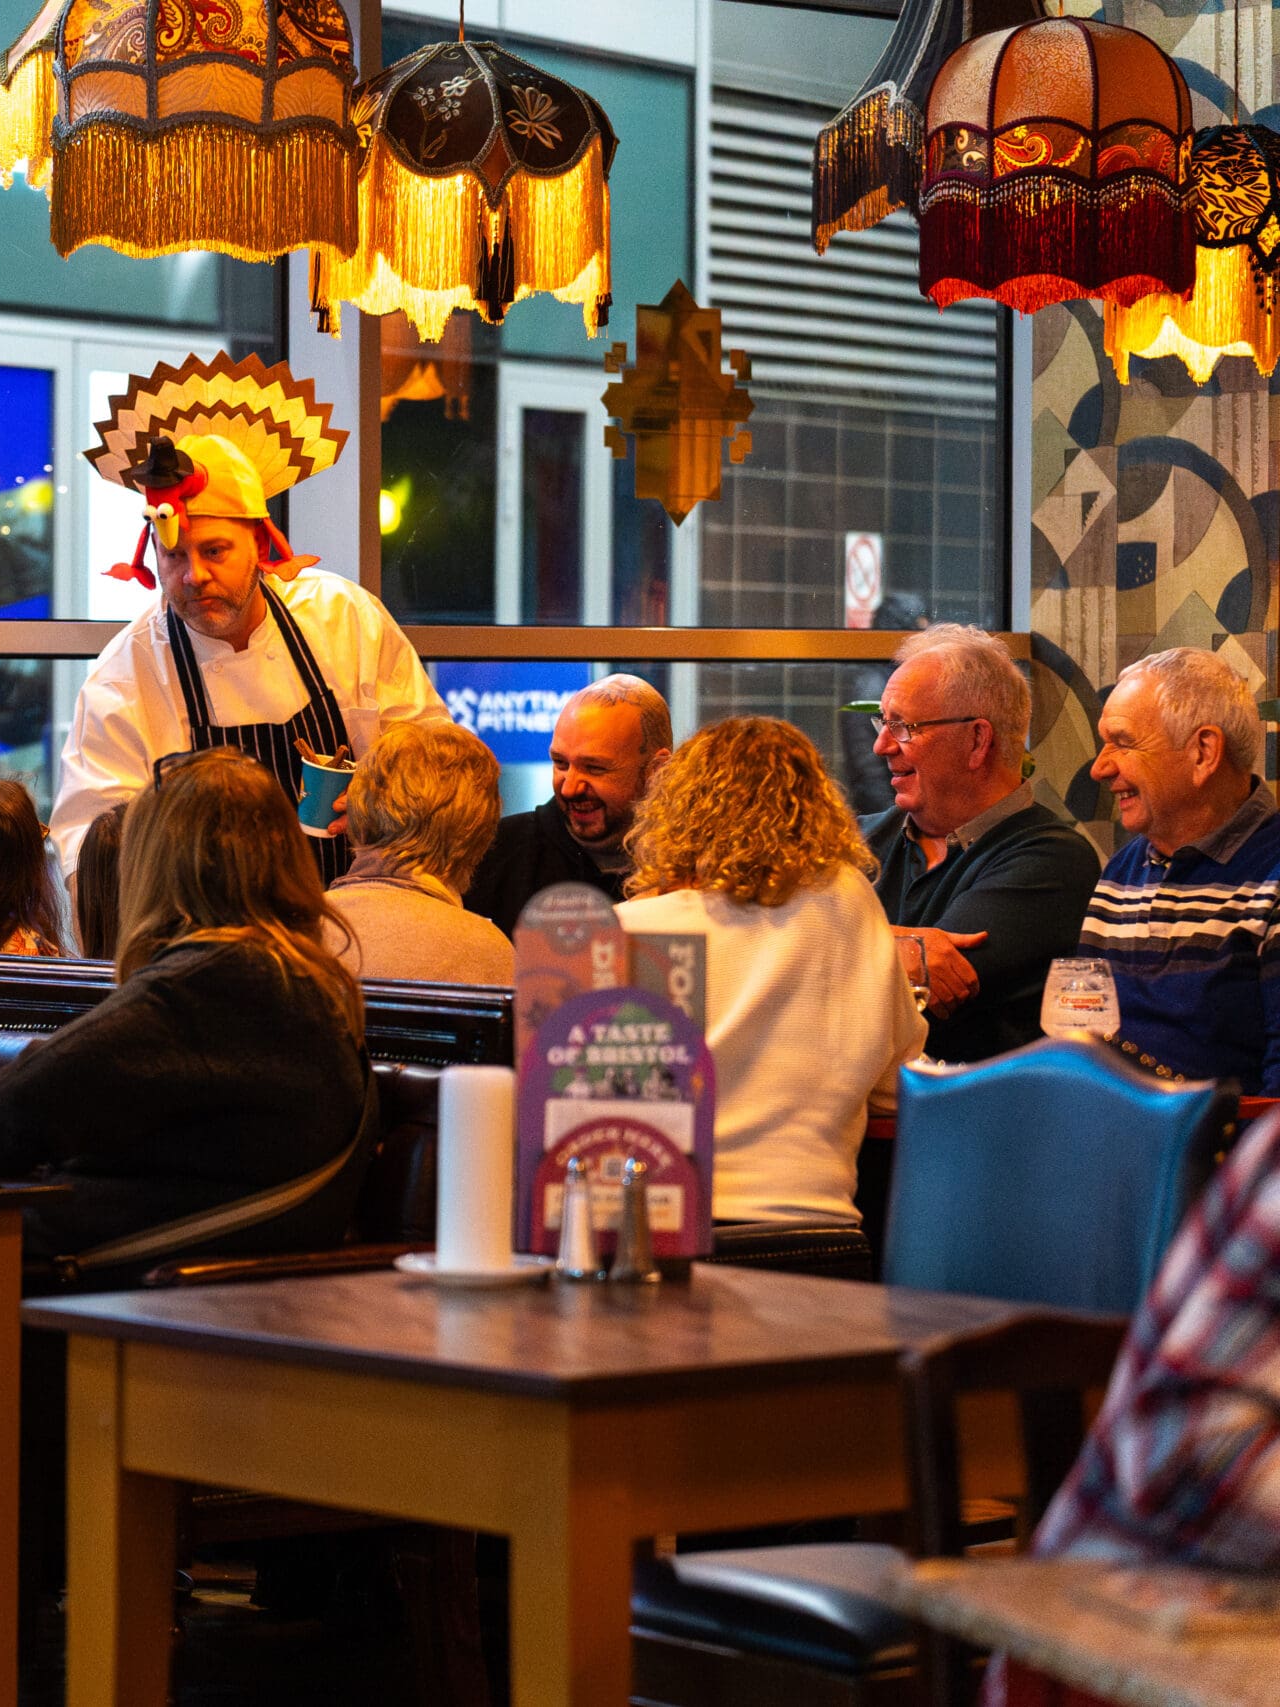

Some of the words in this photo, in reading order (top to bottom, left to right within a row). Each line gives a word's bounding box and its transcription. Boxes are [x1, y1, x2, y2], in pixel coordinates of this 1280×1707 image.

[478, 712, 557, 733] FITNE
[568, 1024, 586, 1044] A
[589, 1023, 670, 1044] TASTE
[546, 1046, 580, 1067] OF
[585, 1044, 691, 1066] BRISTOL
